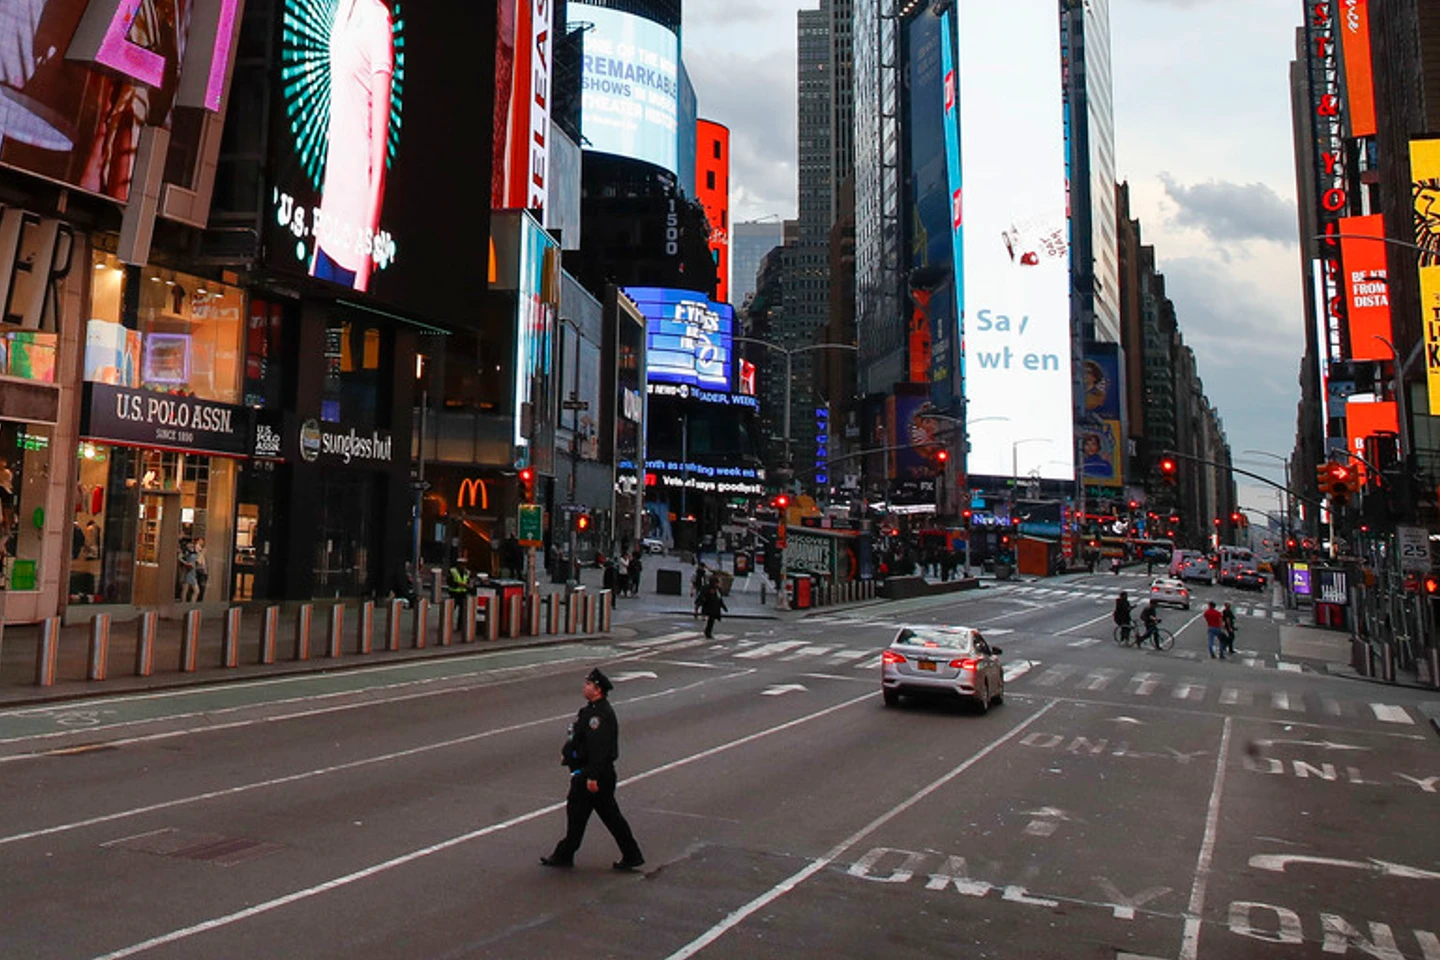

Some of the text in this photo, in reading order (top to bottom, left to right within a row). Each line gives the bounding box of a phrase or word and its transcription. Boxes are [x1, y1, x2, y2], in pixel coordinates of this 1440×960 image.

[582, 76, 632, 97] SHOWS
[1317, 93, 1338, 117] &
[666, 199, 678, 255] 1500
[1353, 283, 1386, 295] FROM
[116, 393, 233, 434] U.S. POLO ASSN.
[322, 426, 392, 464] sunglass hut
[1403, 544, 1428, 557] 25
[849, 846, 1173, 920] ONLY
